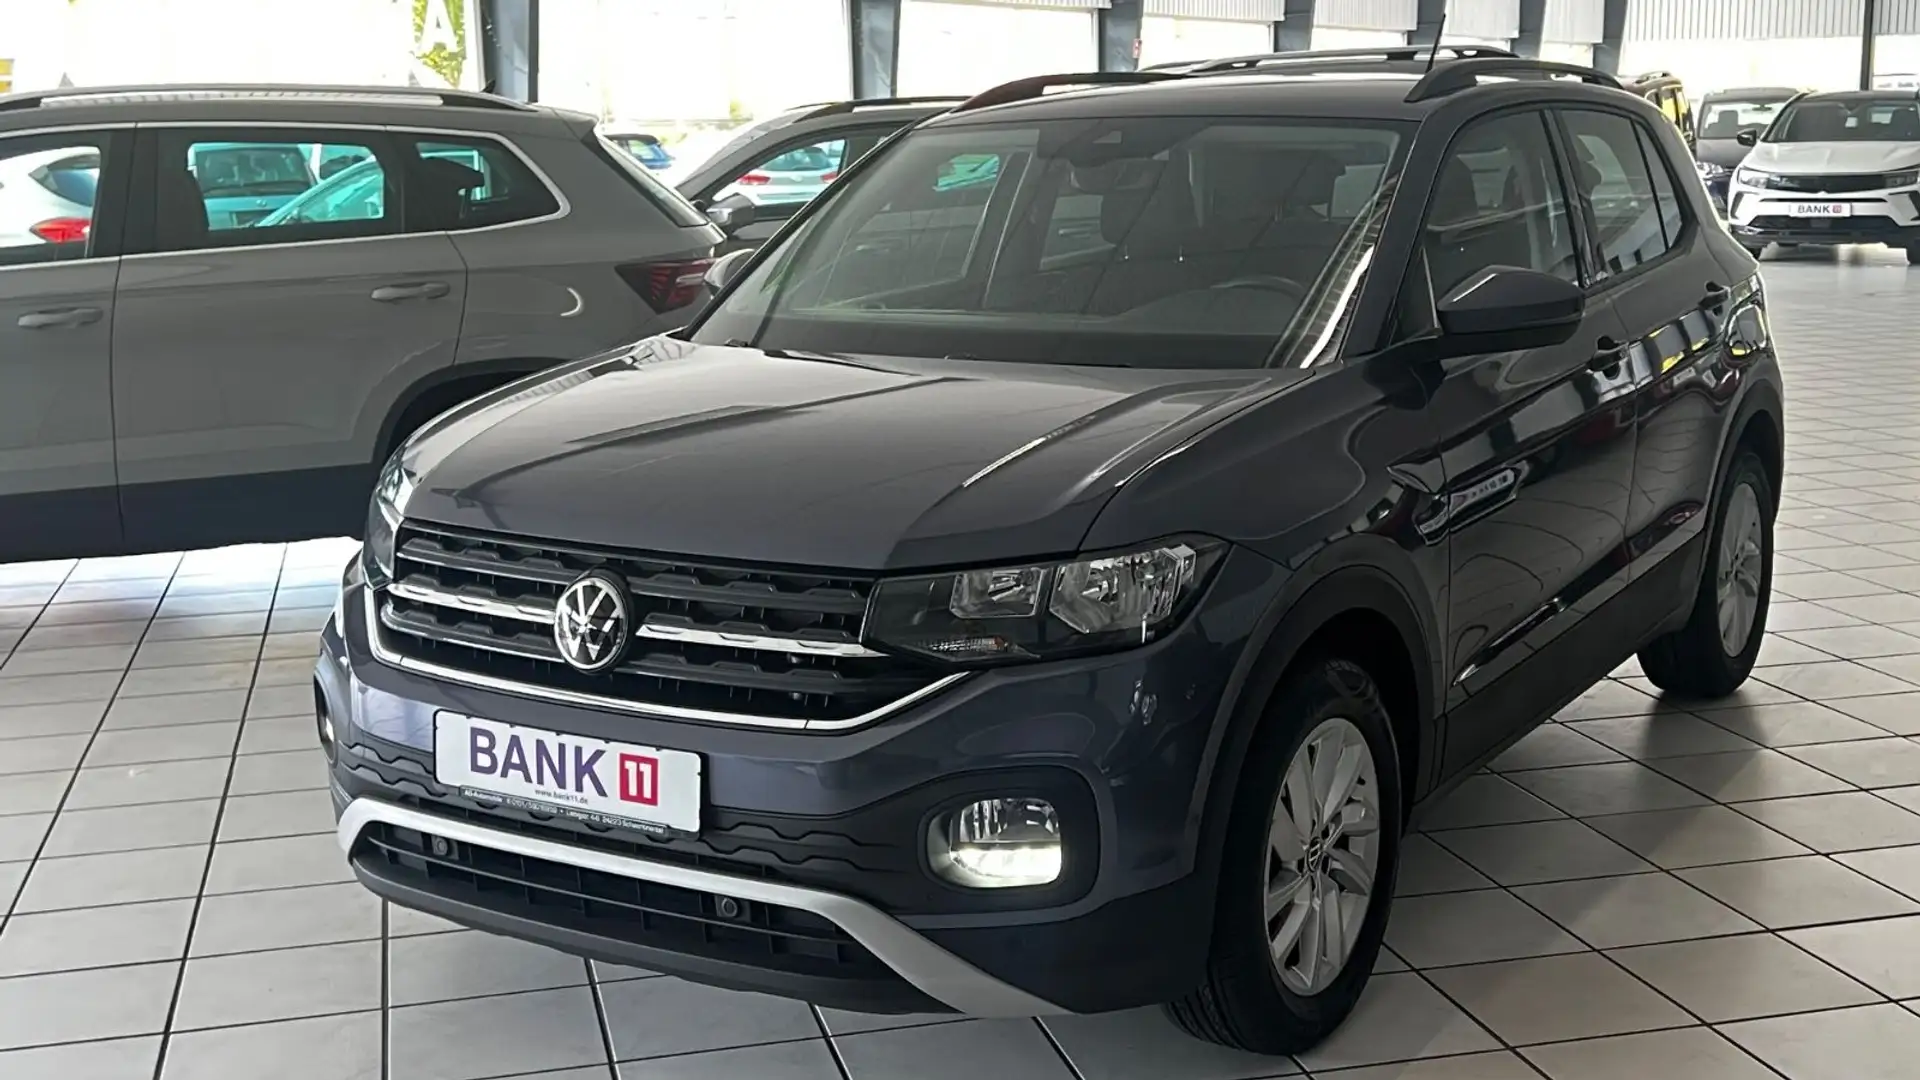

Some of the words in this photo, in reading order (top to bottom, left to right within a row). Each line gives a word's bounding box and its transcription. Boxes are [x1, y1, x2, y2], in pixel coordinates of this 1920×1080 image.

[1797, 204, 1830, 213] BANK
[470, 726, 608, 798] BANK
[623, 758, 653, 801] 11
[535, 788, 588, 806] www.bank11.de
